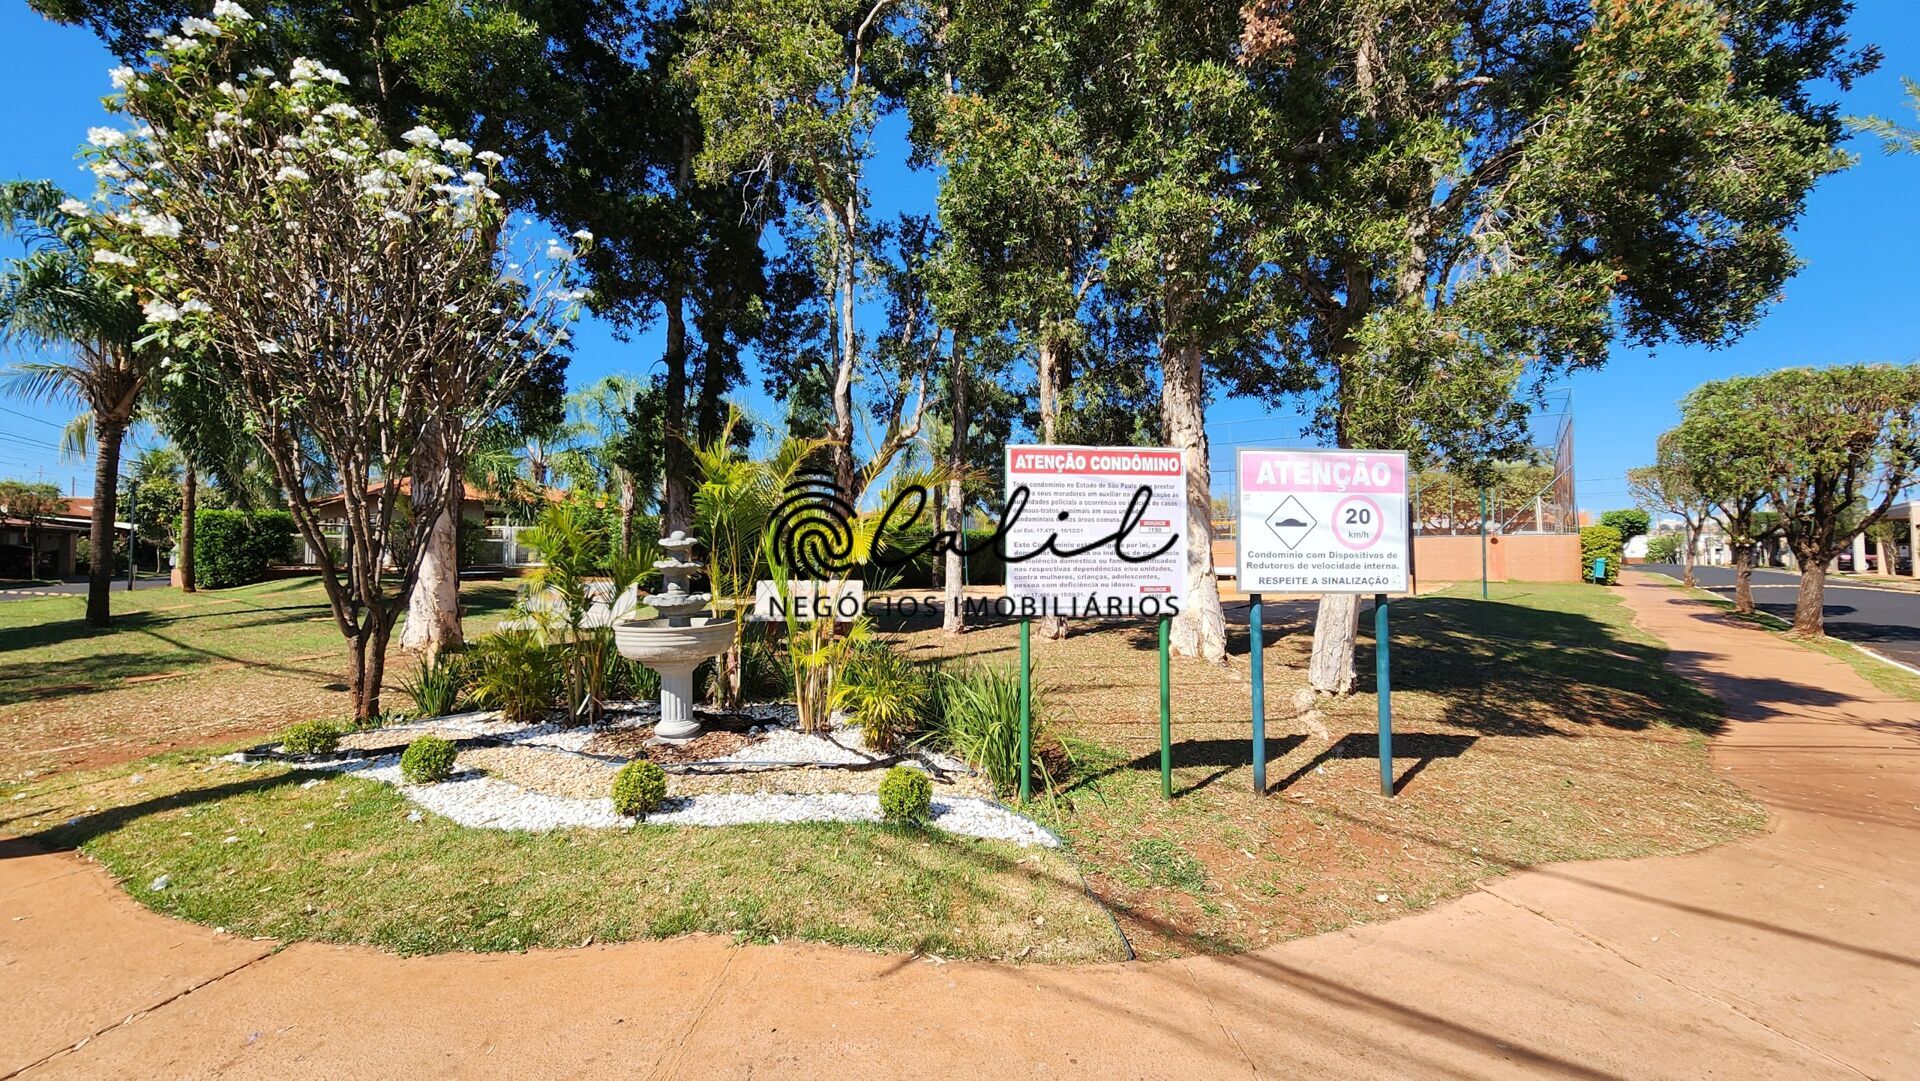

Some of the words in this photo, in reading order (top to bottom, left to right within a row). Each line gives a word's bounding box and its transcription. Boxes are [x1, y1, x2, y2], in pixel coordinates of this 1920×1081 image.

[1015, 452, 1087, 474] ATENÇÃO
[1090, 454, 1180, 472] CONDÔMINO
[1256, 457, 1391, 491] ATENÇÃO
[1345, 508, 1371, 525] 20
[1348, 530, 1370, 540] km/h
[1329, 551, 1385, 560] Dispositivos
[1386, 551, 1398, 559] de
[1246, 562, 1295, 570] Redutores
[1297, 562, 1309, 570] de
[1311, 562, 1362, 570] velocidade
[1364, 562, 1400, 570] interna.
[1258, 576, 1309, 585] RESPEITE
[1311, 576, 1319, 585] A
[1321, 575, 1389, 587] SINALIZAÇÃO
